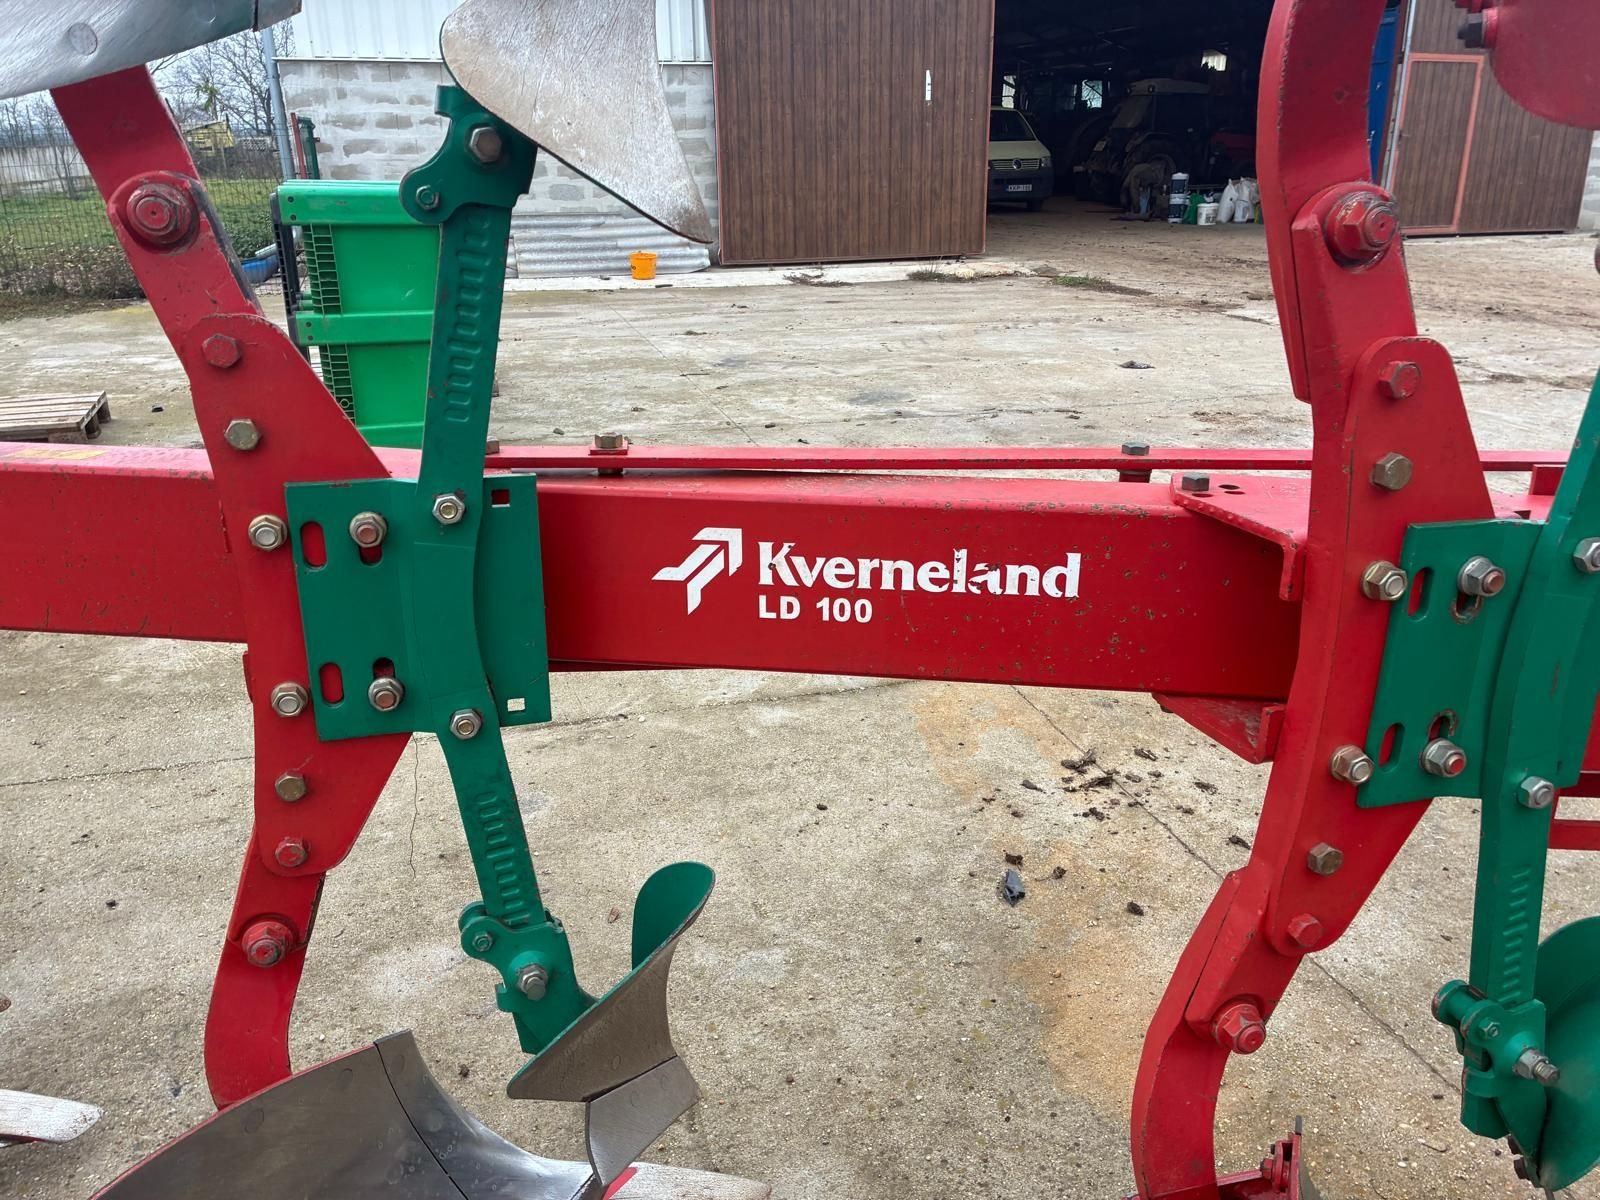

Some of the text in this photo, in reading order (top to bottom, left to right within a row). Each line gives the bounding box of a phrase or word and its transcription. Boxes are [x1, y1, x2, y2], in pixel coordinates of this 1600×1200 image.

[758, 542, 1081, 598] Kverneland
[759, 595, 873, 623] LD 100
